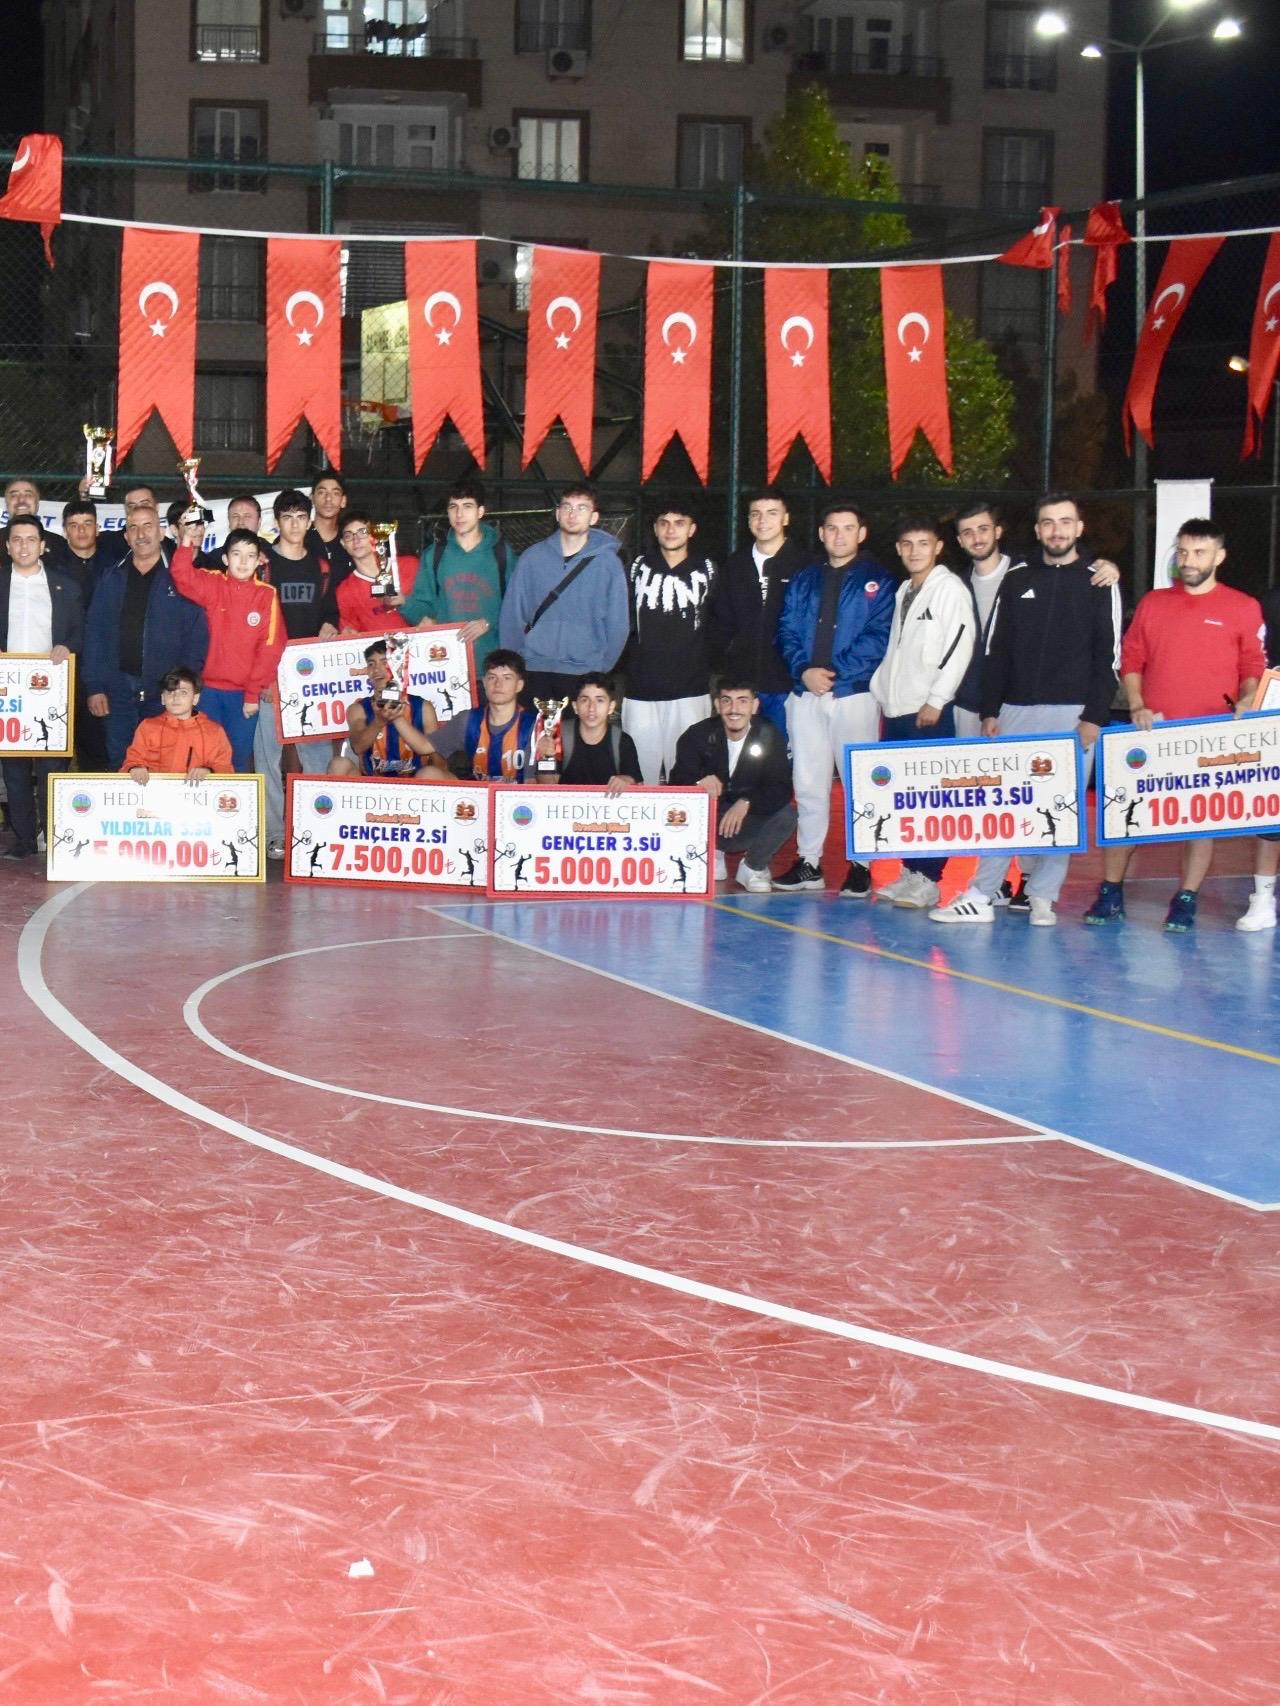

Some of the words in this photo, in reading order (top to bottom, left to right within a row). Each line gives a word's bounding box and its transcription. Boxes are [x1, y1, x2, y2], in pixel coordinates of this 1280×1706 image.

[283, 584, 312, 600] LOFT
[322, 648, 361, 668] HEDİ
[302, 679, 362, 698] GENÇLER
[1158, 735, 1227, 758] HEDİYE
[1234, 728, 1277, 753] ÇEKİ
[502, 749, 525, 770] 10
[904, 757, 971, 776] HEDİYE
[977, 753, 1020, 776] ÇEKİ
[1136, 772, 1210, 794] BÜYÜKLER
[1215, 764, 1280, 789] ŞAMPİYO
[103, 789, 144, 806] HEDİ
[341, 795, 402, 811] HEDİYE
[408, 797, 446, 815] ÇEKİ
[893, 785, 987, 810] BÜYÜKLER
[992, 780, 1034, 806] 3.SÜ
[547, 803, 611, 820] HEDİYE
[617, 803, 657, 822] ÇEKİ
[100, 820, 173, 836] YILDIZLAR
[339, 824, 411, 844] GENÇLER
[415, 825, 448, 844] 2.Sİ
[541, 835, 617, 854] GENÇLER
[623, 832, 661, 852] 3.SÜ
